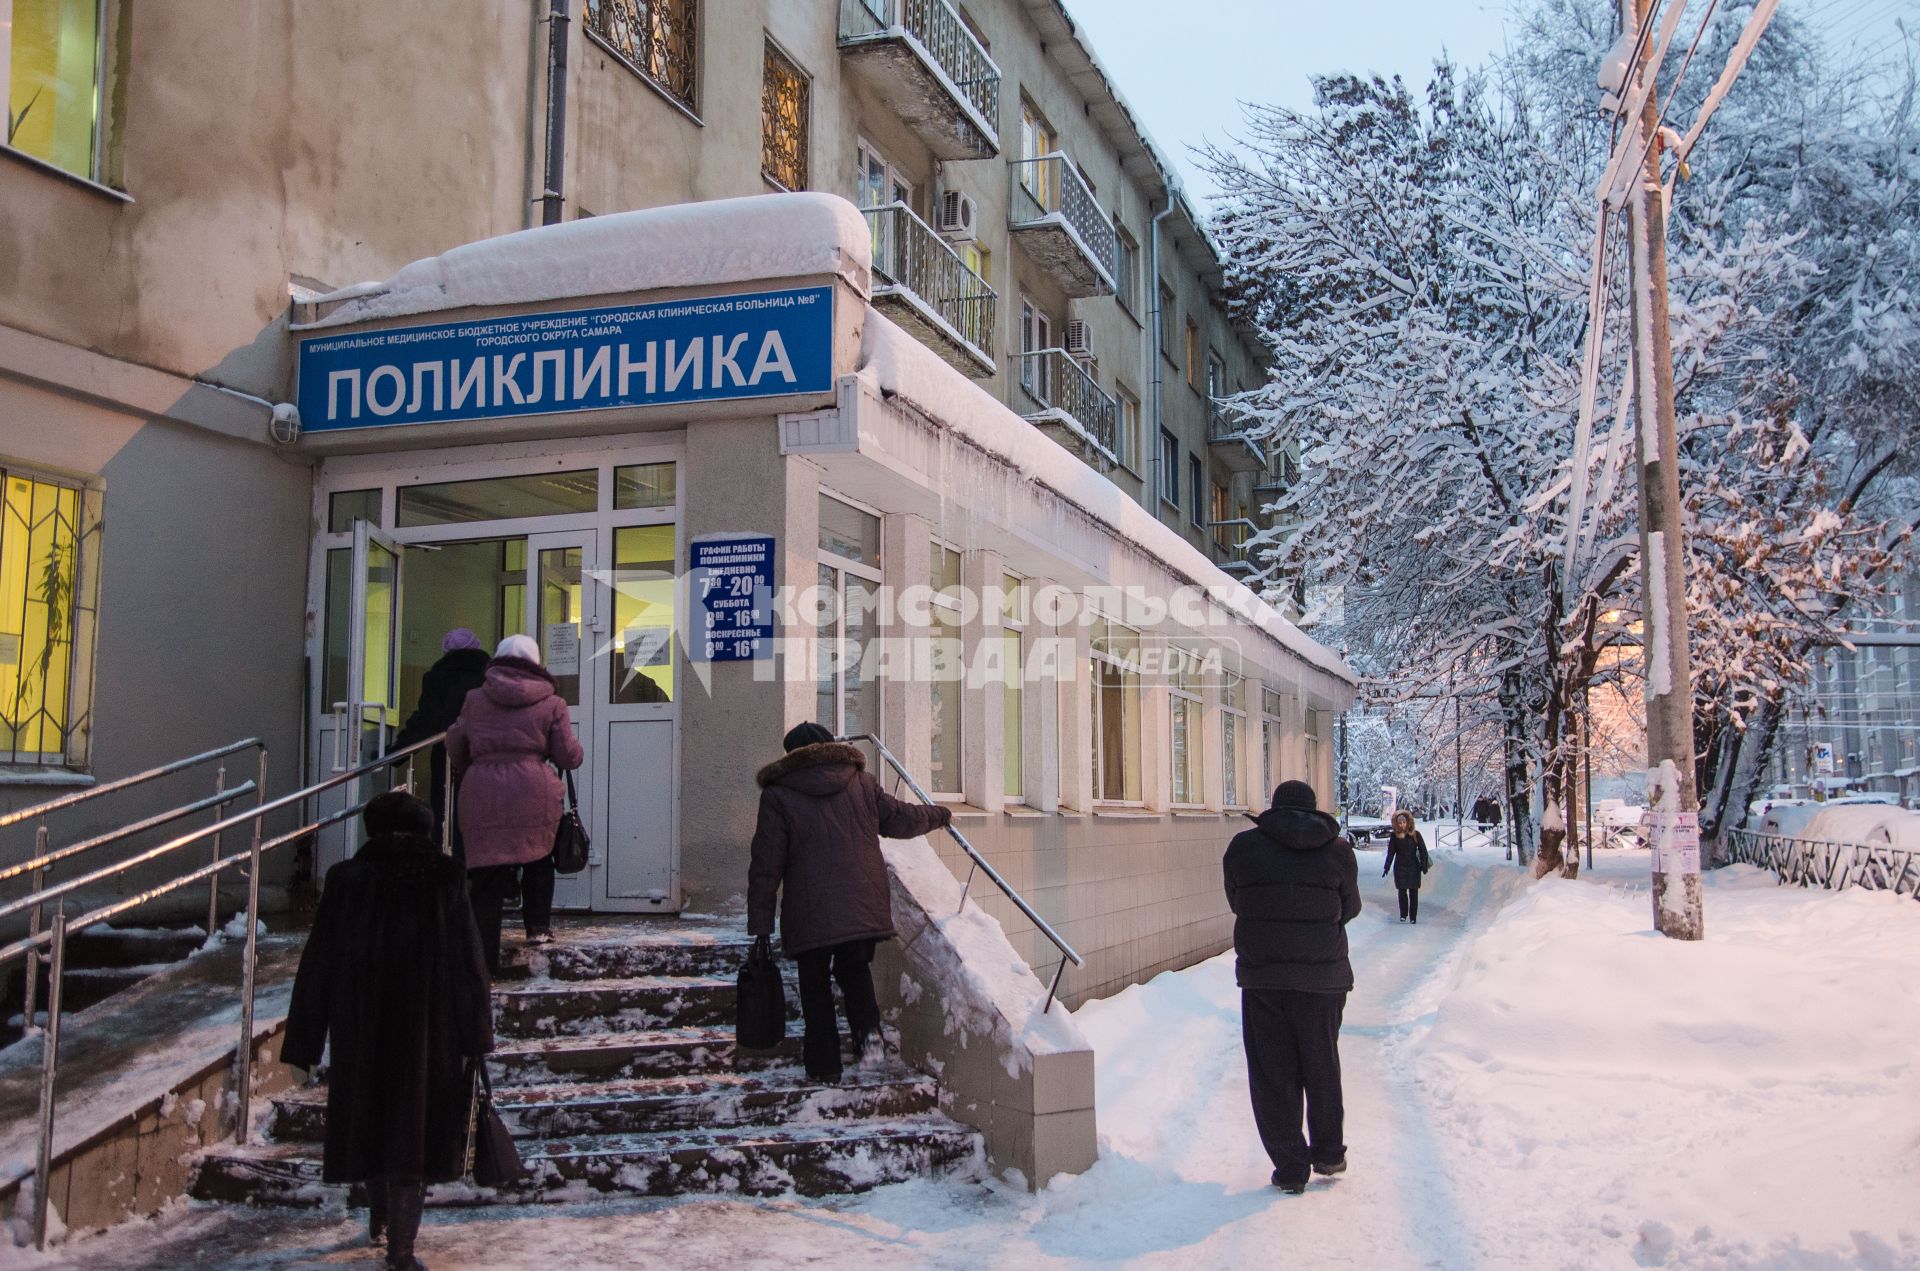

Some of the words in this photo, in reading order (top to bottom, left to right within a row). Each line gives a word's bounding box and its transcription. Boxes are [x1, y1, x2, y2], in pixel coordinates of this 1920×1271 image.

[309, 336, 385, 353] МУНИЦИПАЛЬНОЕ
[387, 329, 456, 345] МЕДИЦИНСКОЕ
[458, 322, 520, 338] БЮДЖЕТНОЕ
[522, 316, 588, 331] УЧРЕЖДЕНИЕ
[658, 303, 733, 318] КЛИНИЧЕСКАЯ
[735, 296, 795, 311] БОЛЬНИЦА
[476, 333, 540, 347] ГОРОДСКОГО
[542, 329, 579, 342] ОКРУГА
[581, 325, 622, 338] САМАРА
[327, 329, 797, 420] ПОЛИКЛИНИКА
[700, 546, 731, 556] ГРАФИК
[733, 544, 765, 553] РАБОТЫ
[700, 554, 765, 565] ПОЛИКЛИНИКИ
[708, 565, 757, 576] ЕЖЕДНЕВНО
[713, 599, 750, 609] СУББОТА
[705, 629, 761, 639] ВОСКРЕСЕНЬЕ
